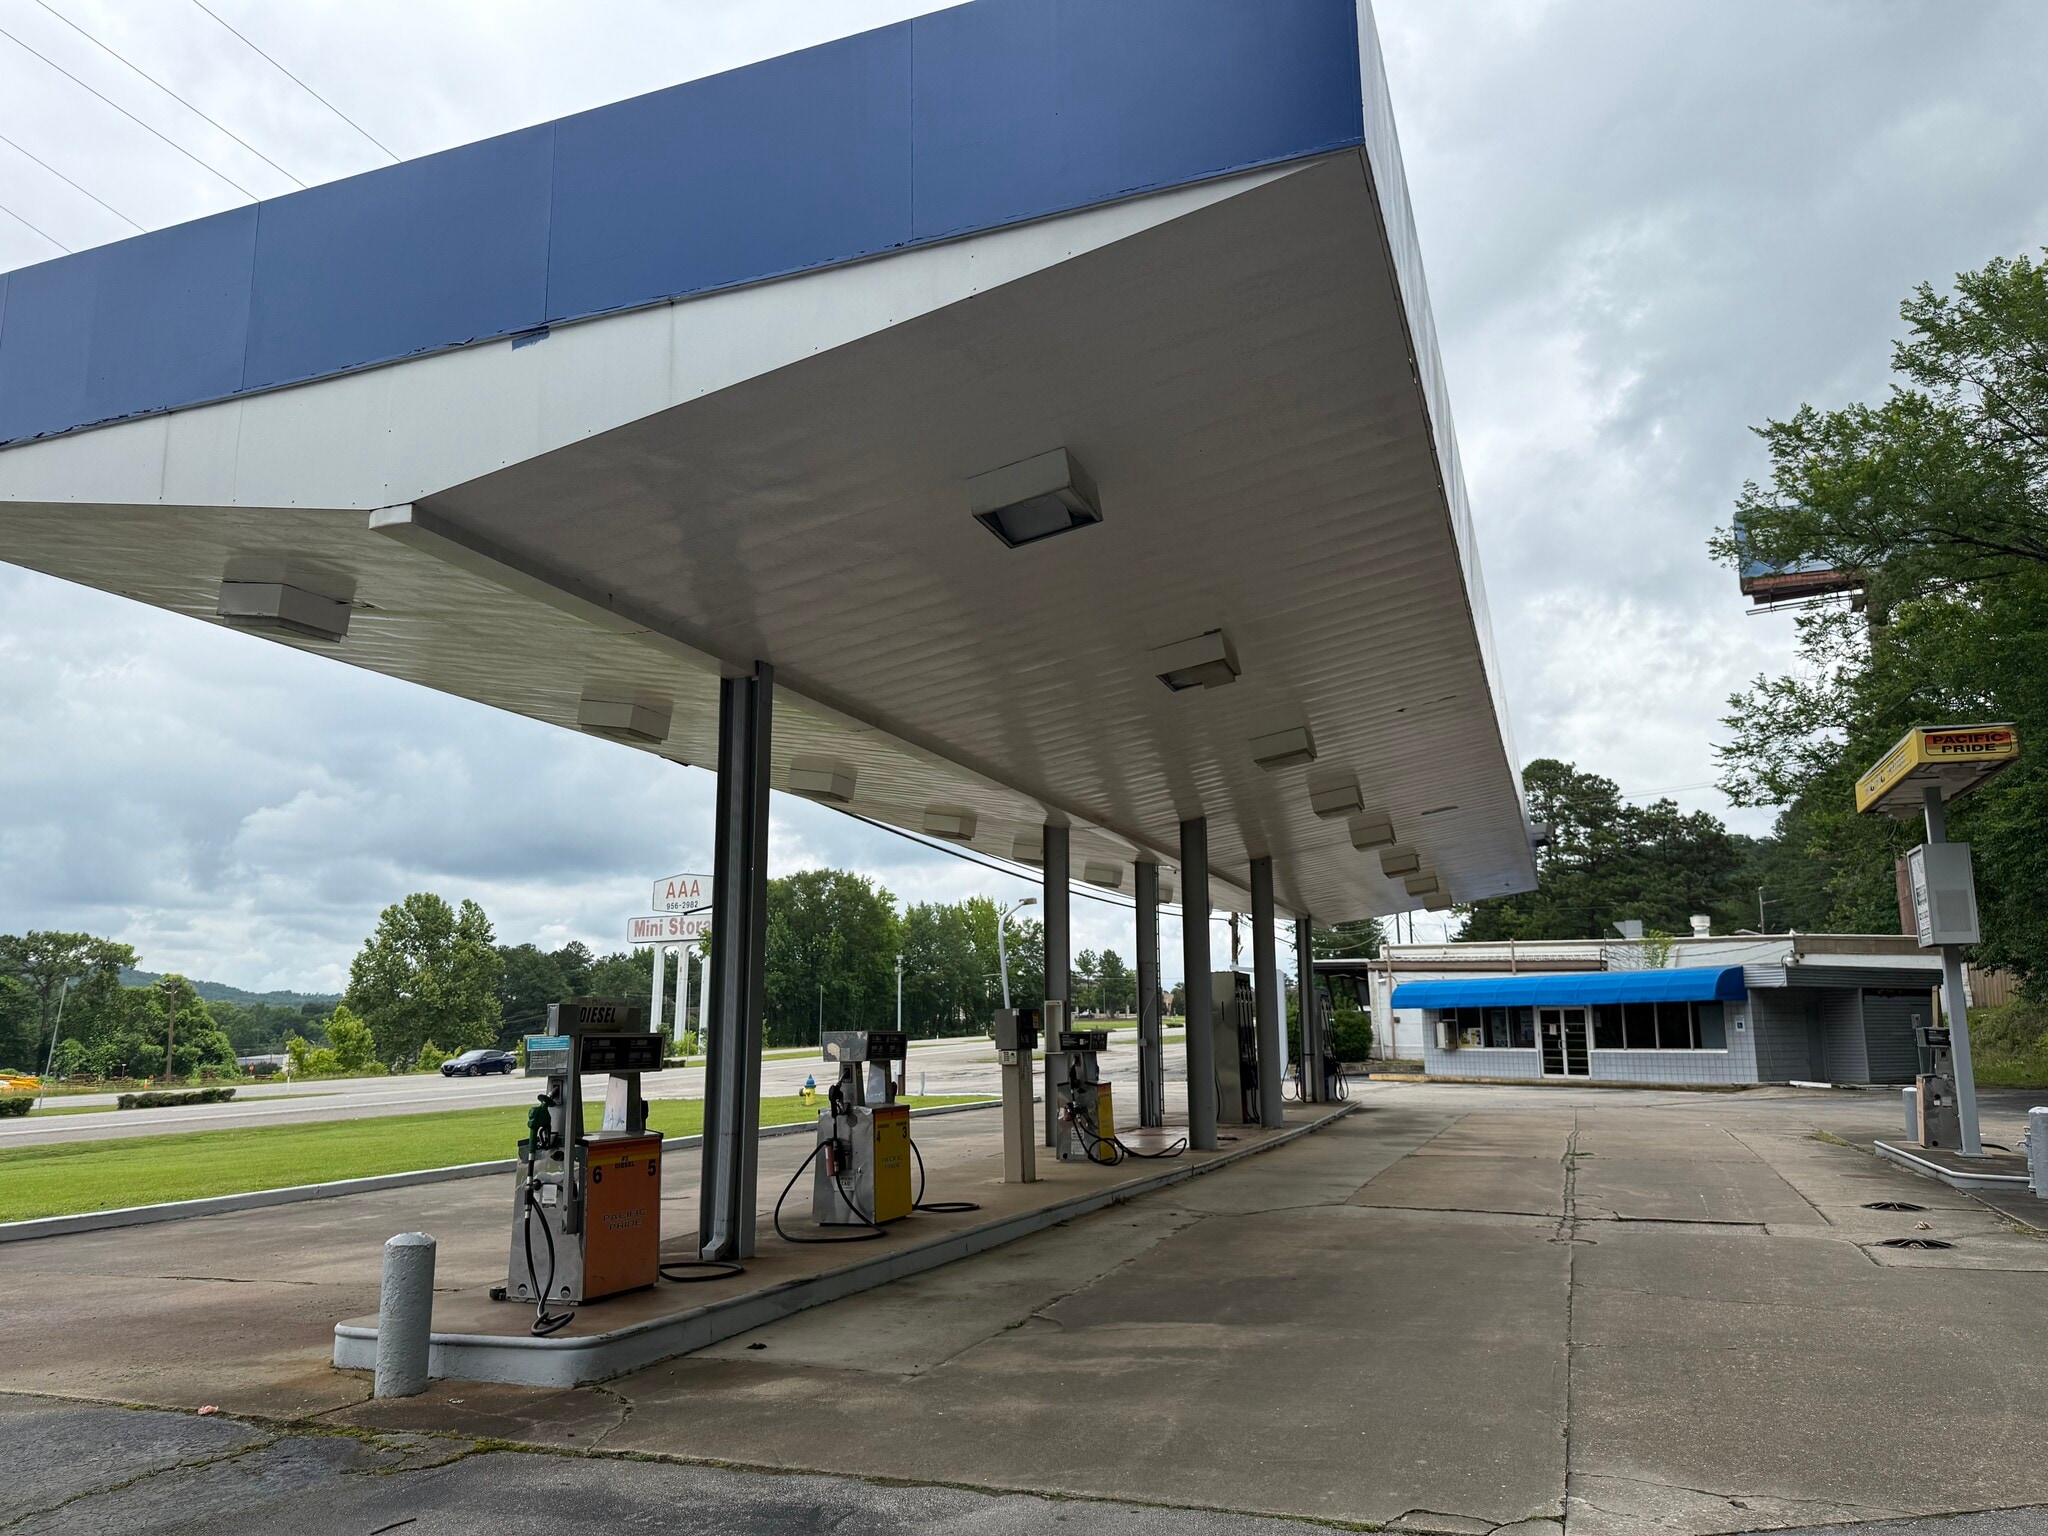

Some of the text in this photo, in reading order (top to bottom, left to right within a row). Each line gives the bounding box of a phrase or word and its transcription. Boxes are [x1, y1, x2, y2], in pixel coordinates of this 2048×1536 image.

[1932, 733, 2004, 744] PACIFIC
[1941, 743, 1997, 753] PRIDE
[665, 879, 700, 899] AAA
[666, 900, 699, 910] 956-2982
[634, 919, 663, 937] Mini
[580, 1006, 616, 1024] DIESEL
[877, 1130, 881, 1143] 4
[903, 1126, 907, 1138] 3
[592, 1159, 657, 1184] 6 5
[614, 1161, 636, 1169] DIESEL
[603, 1207, 647, 1222] PACIFIC
[608, 1219, 642, 1231] PRIDE
